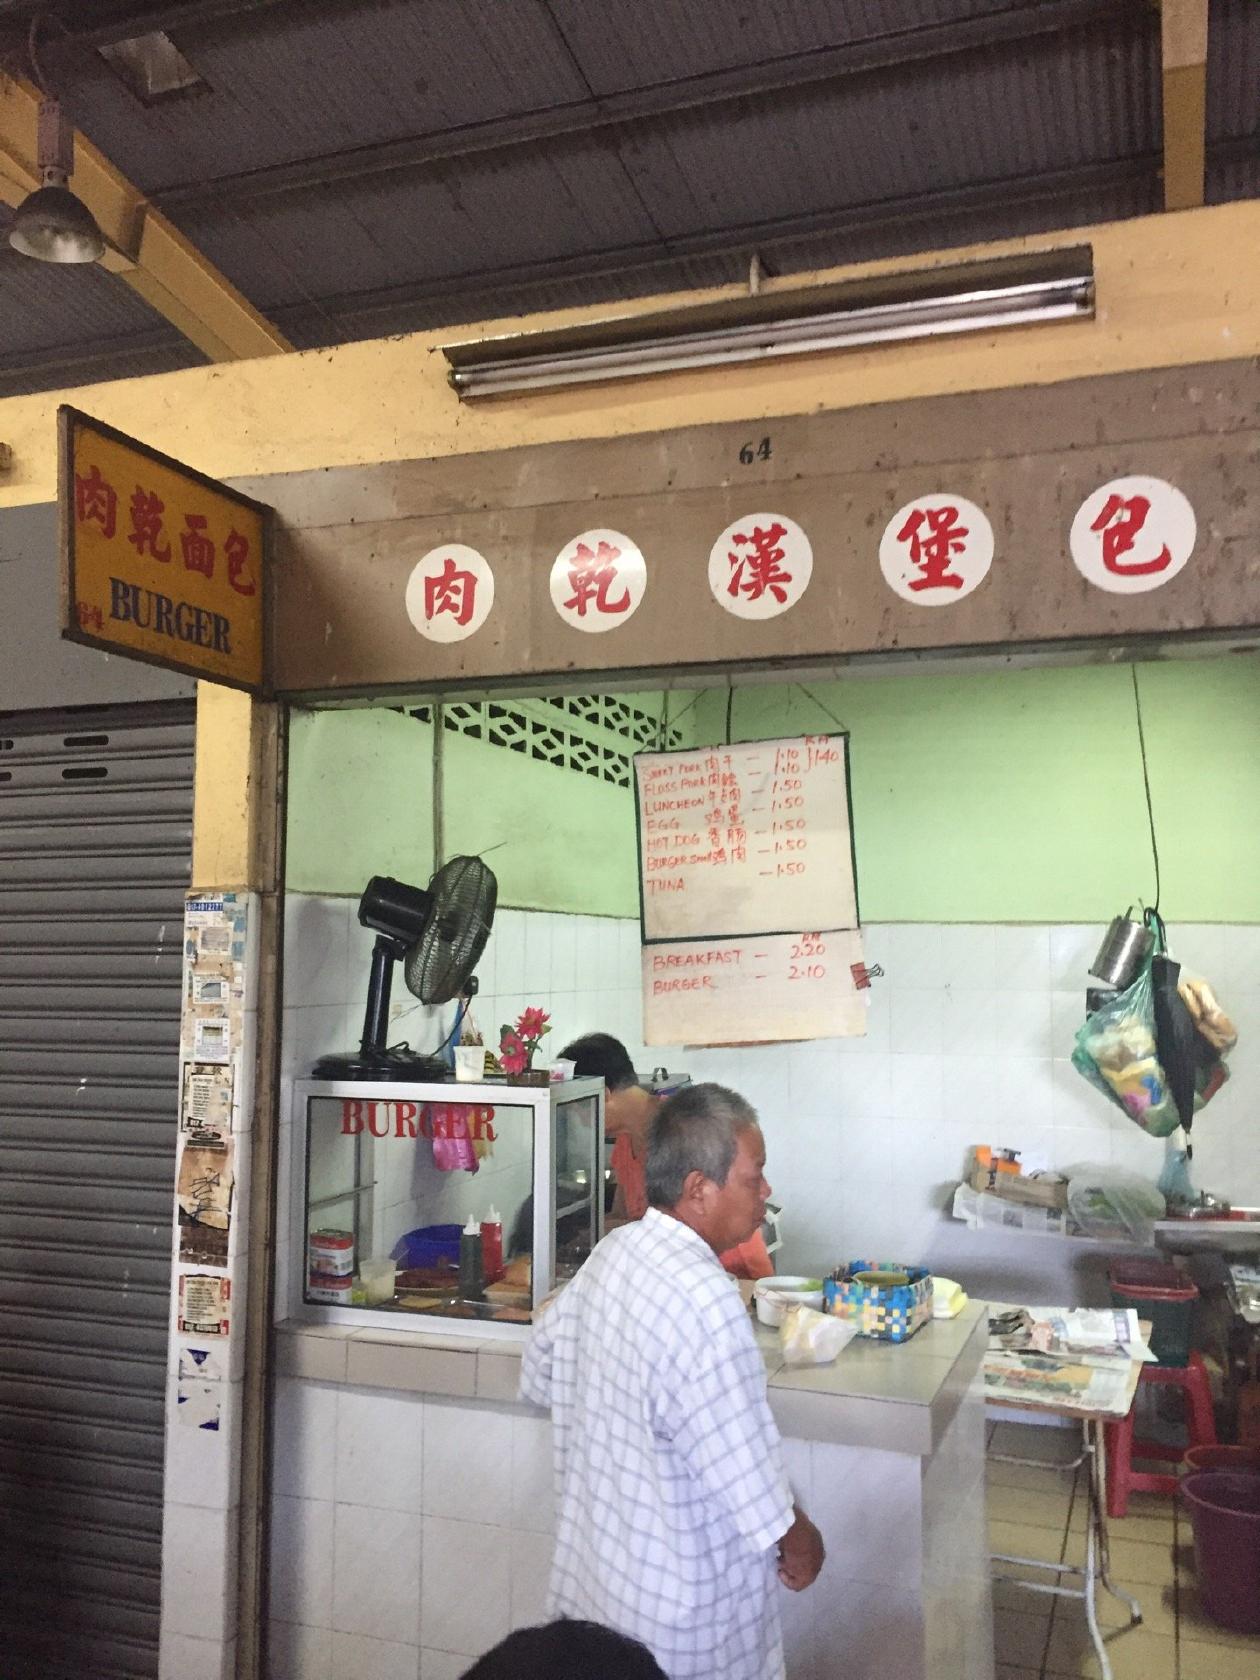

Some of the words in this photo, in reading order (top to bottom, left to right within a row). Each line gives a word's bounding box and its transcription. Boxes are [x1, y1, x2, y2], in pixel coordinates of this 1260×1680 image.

[739, 437, 772, 465] 64
[75, 465, 256, 596] 肉乾面包
[424, 494, 1172, 626] 肉乾漢堡包
[109, 577, 232, 654] BURGER
[644, 796, 704, 816] LUNCHEON
[772, 780, 802, 795] 1.50
[647, 817, 680, 831] EGG
[771, 796, 805, 813] 1.50
[647, 836, 669, 852] HOT
[773, 818, 807, 835] 1.50
[775, 838, 808, 855] 1.50
[646, 877, 686, 898] TUNA
[777, 862, 806, 878] 1.50
[653, 949, 743, 971] BREAKFAST
[790, 943, 826, 961] 2.20
[653, 975, 717, 996] BURGER
[788, 965, 826, 981] 2.10
[340, 1099, 498, 1142] BURGER
